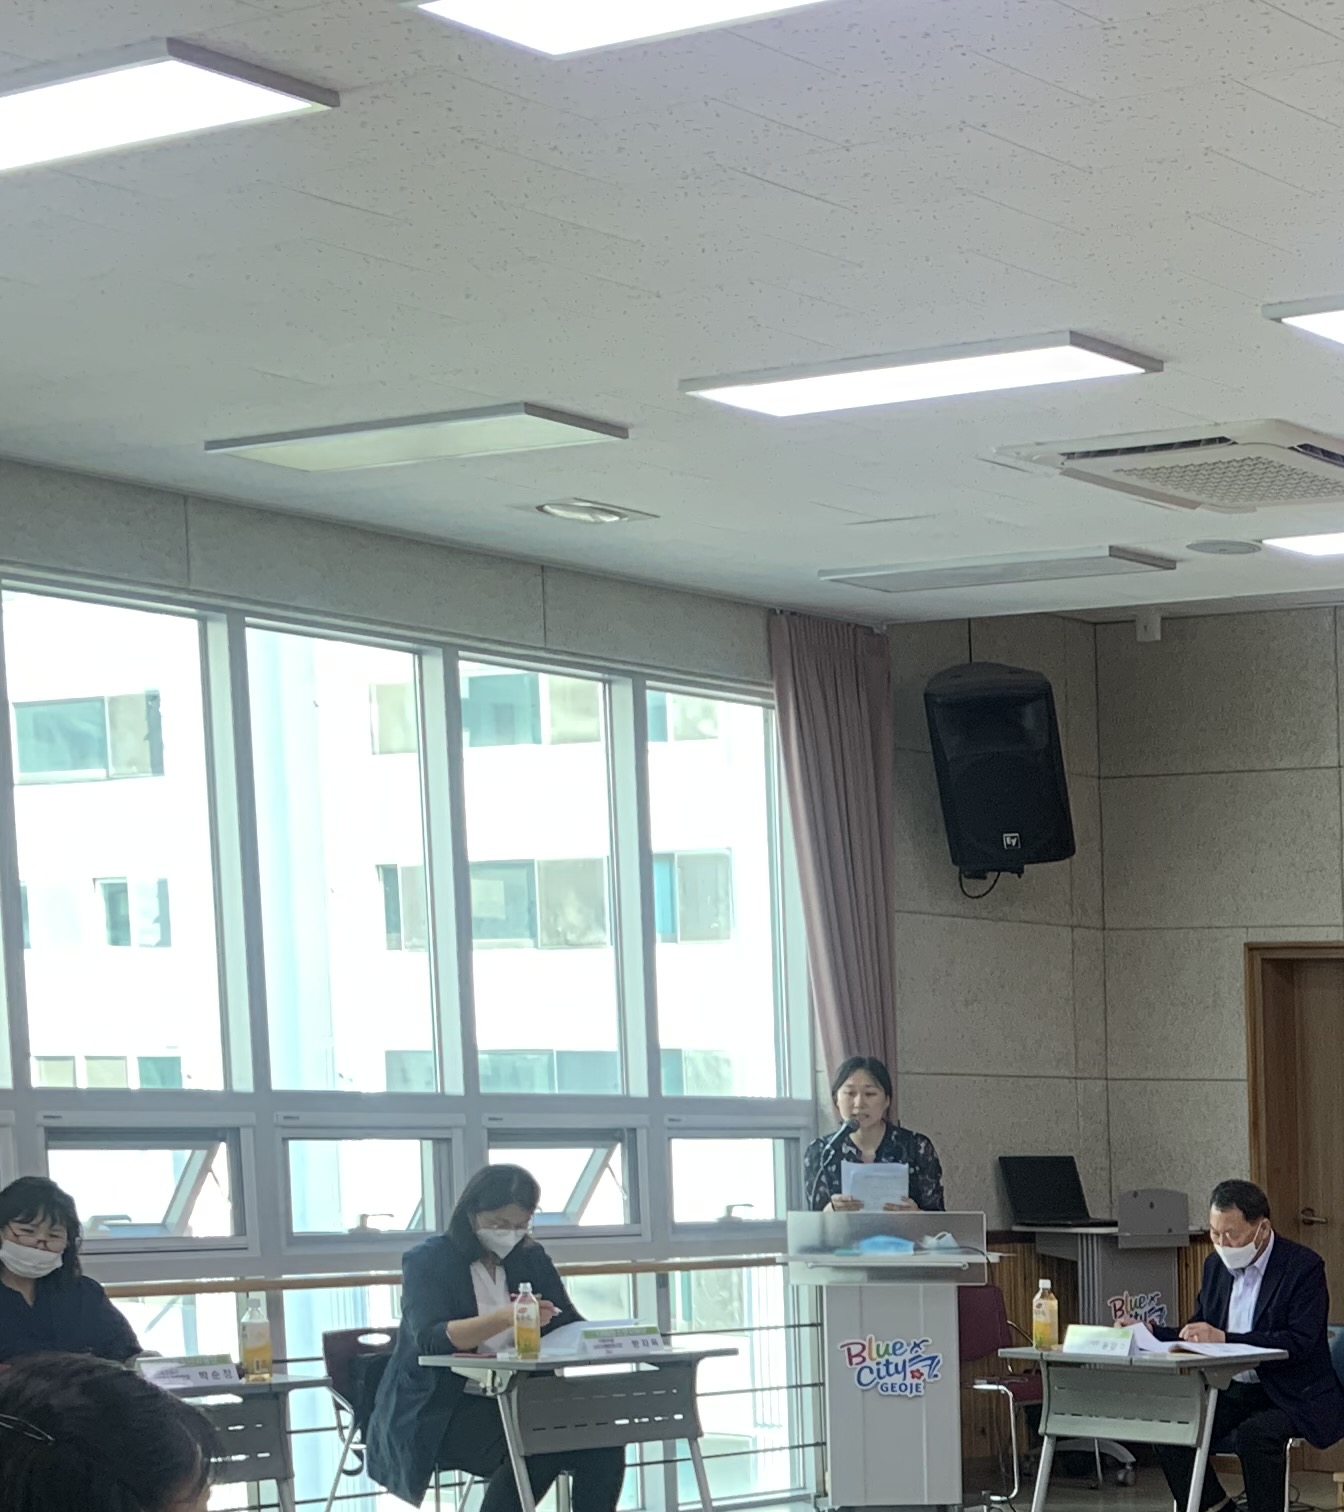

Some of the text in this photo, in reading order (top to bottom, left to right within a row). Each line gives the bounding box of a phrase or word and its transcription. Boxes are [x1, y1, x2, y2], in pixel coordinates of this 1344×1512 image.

[840, 1336, 908, 1366] Blue
[857, 1358, 907, 1387] City
[880, 1382, 922, 1394] GEOJE
